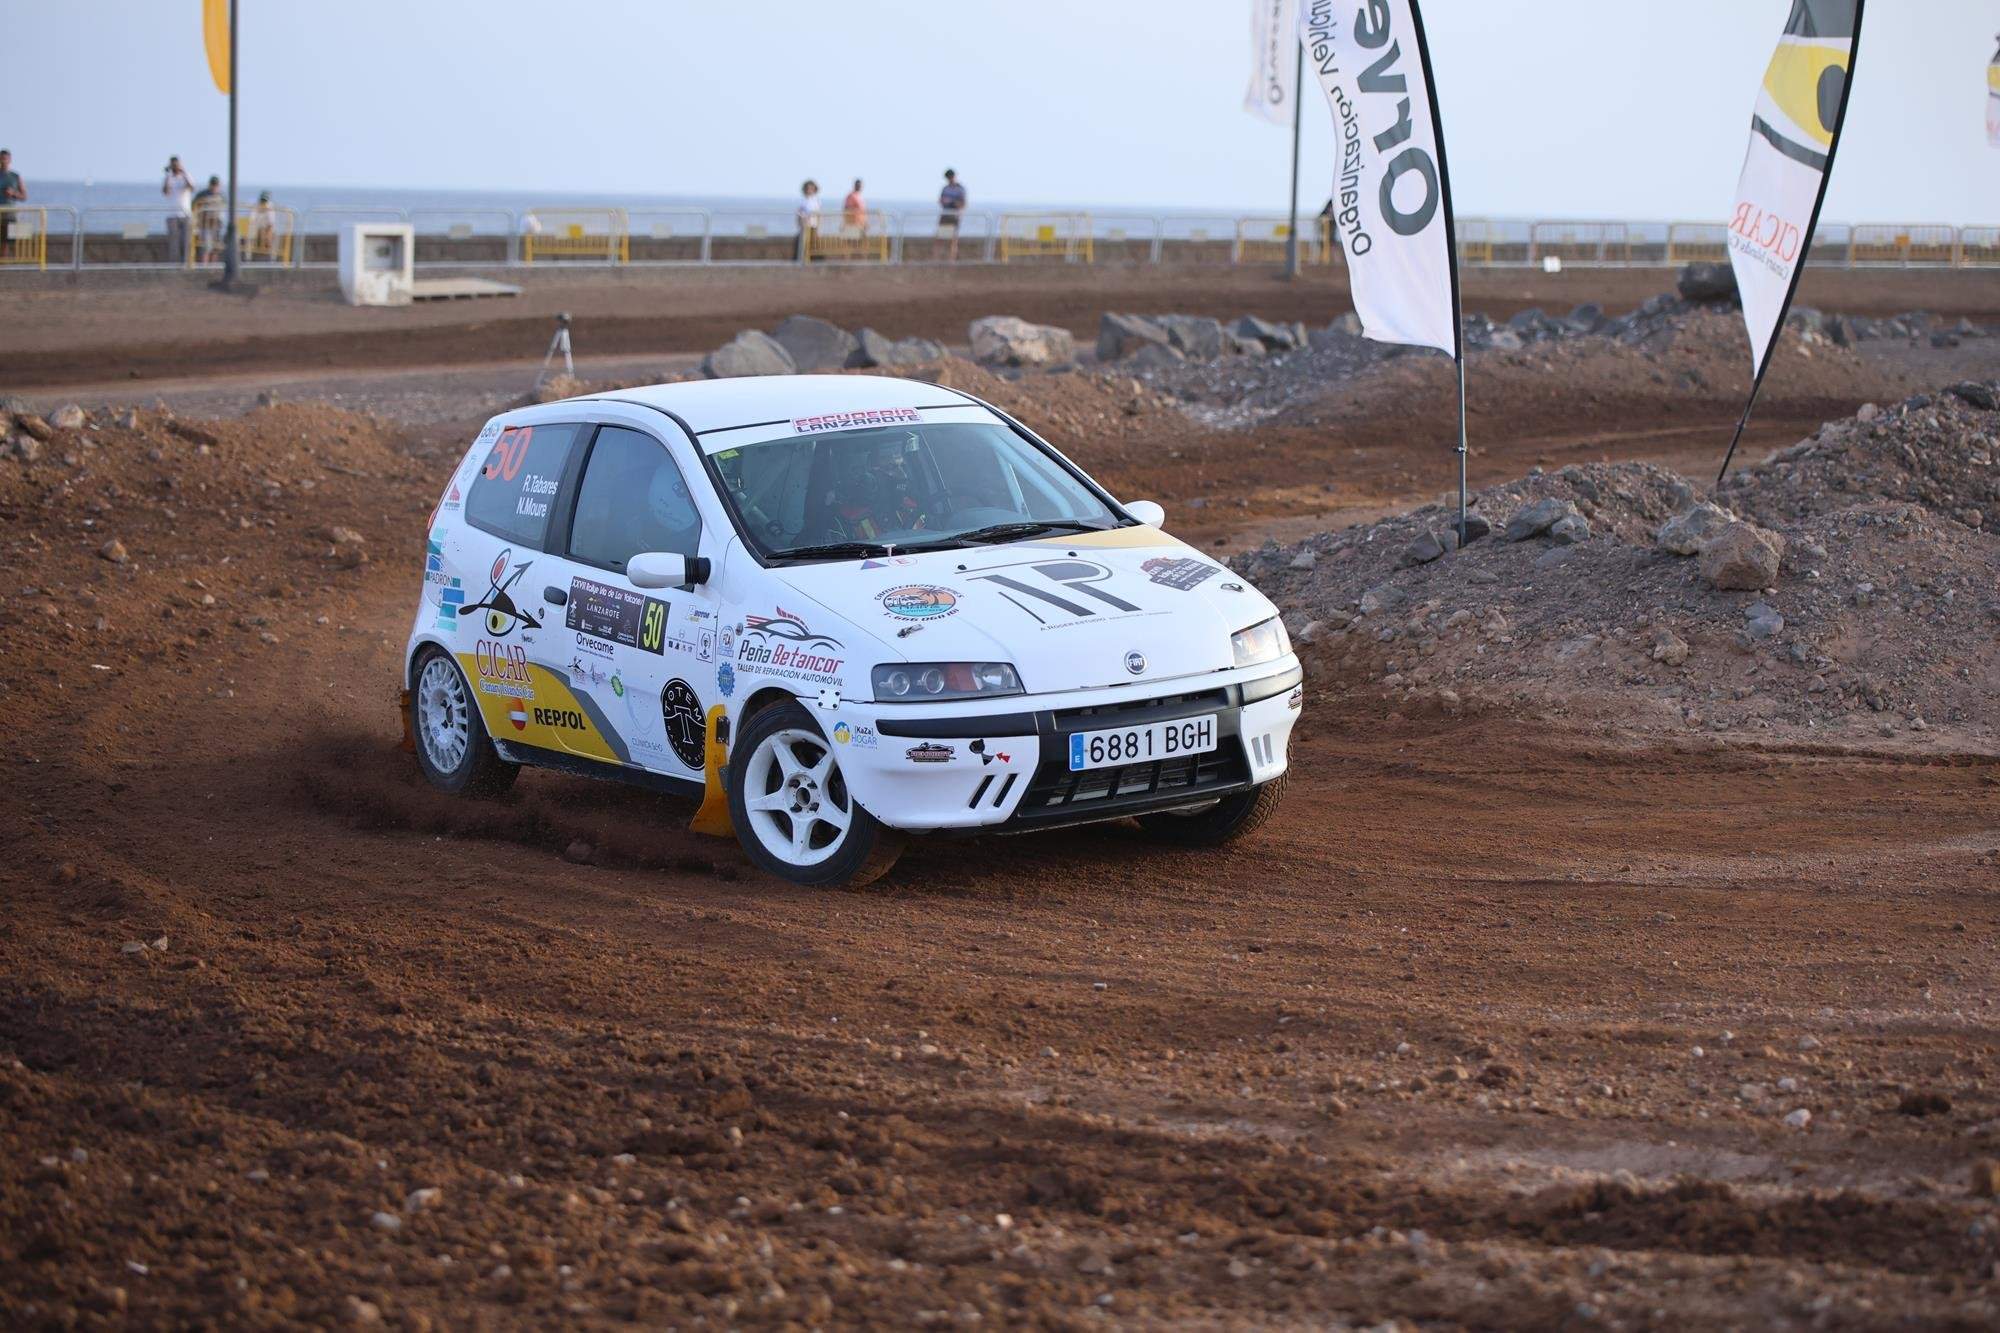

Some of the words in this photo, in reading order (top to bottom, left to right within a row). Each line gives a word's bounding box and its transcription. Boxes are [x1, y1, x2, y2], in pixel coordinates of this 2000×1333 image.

[796, 414, 920, 433] LANZAROTE
[486, 425, 534, 481] 50
[516, 496, 548, 518] N.Moure
[586, 603, 620, 620] LANZAROTE
[643, 601, 664, 650] 50
[576, 632, 614, 655] Orvecame
[476, 639, 532, 683] CICAR
[738, 639, 772, 664] Peña
[771, 643, 845, 674] Betancor
[1129, 657, 1145, 668] FIAT
[737, 663, 755, 673] TALLER
[755, 666, 762, 674] DE
[479, 679, 501, 697] Canary
[500, 682, 522, 698] Islands
[522, 685, 535, 700] Car
[533, 707, 586, 731] REPSOL
[852, 734, 877, 745] HOGAR
[1074, 755, 1081, 763] E
[1090, 728, 1153, 763] 6881
[1166, 719, 1211, 753] BGH
